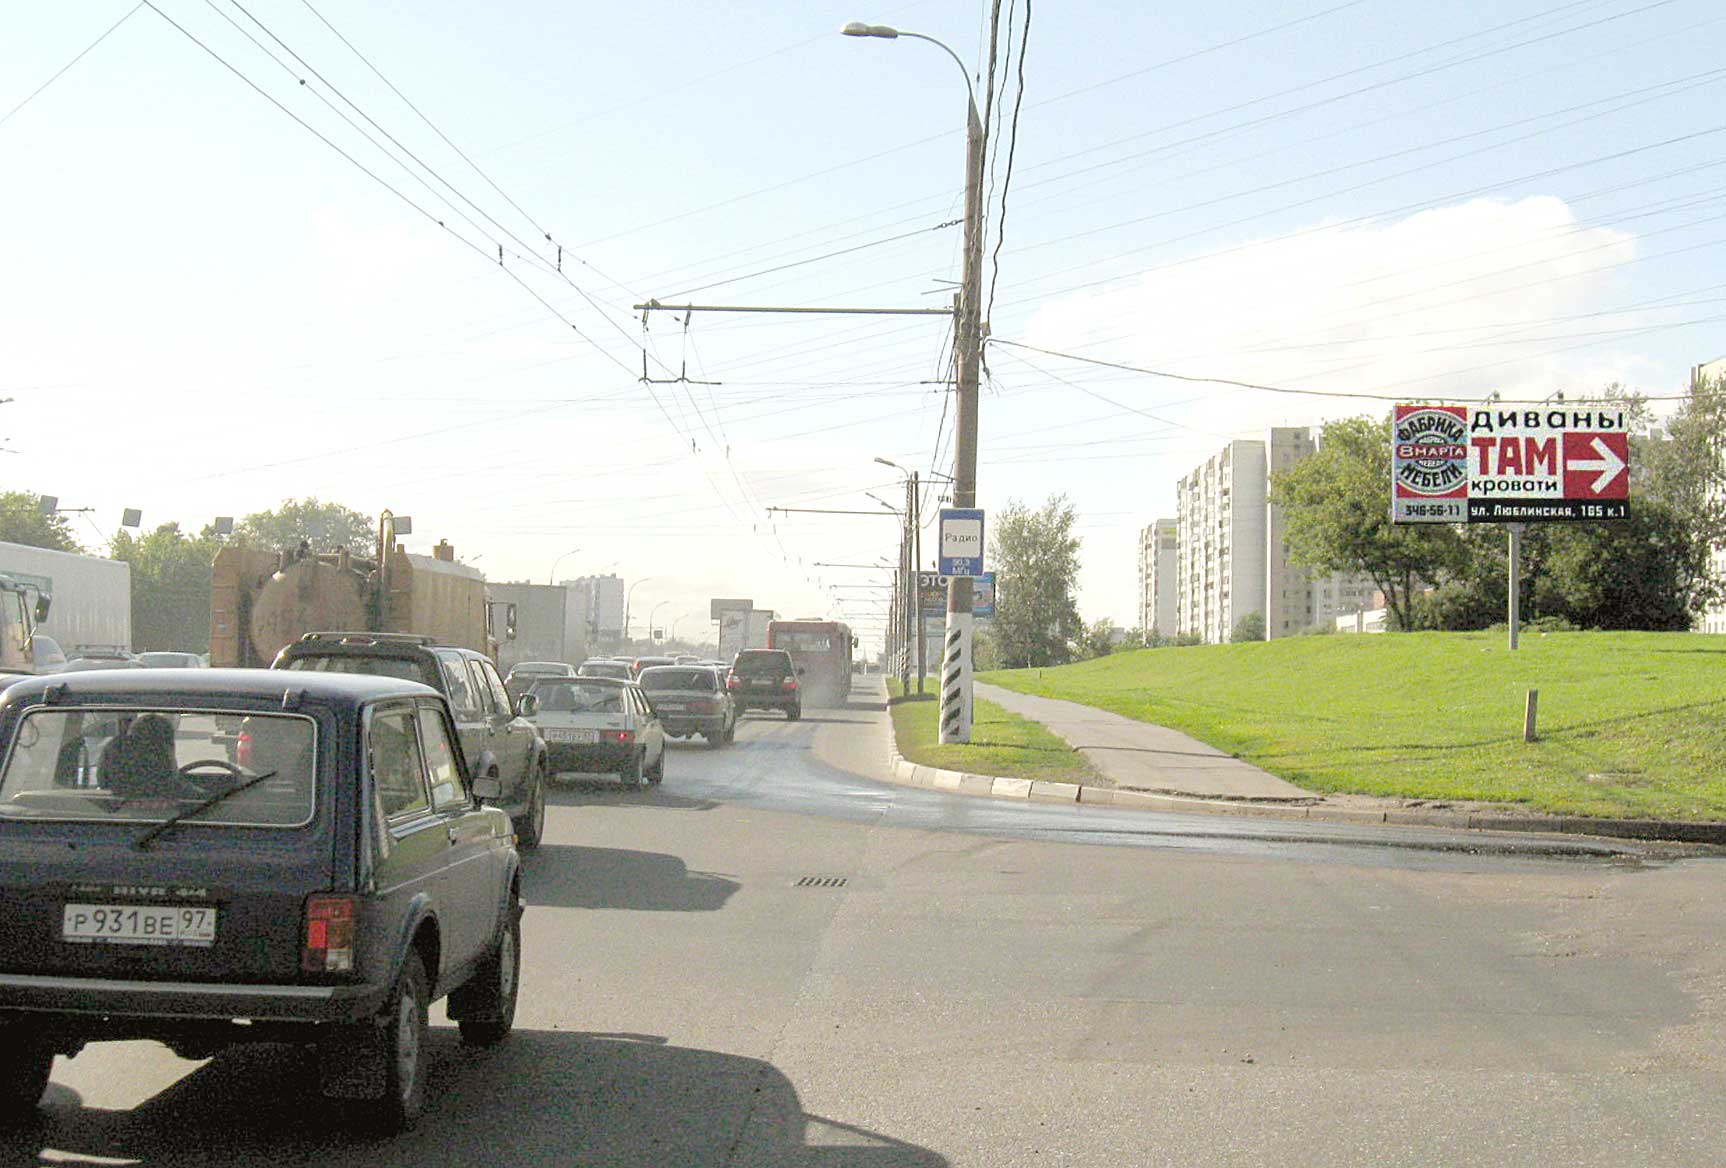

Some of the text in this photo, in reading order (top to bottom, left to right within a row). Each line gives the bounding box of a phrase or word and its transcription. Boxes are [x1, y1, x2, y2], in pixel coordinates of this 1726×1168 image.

[1398, 415, 1465, 442] ФАБРИКА
[1471, 410, 1624, 433] диваны
[1471, 436, 1558, 476] ТАМ
[1400, 463, 1464, 488] МЕБЕЛИ
[1471, 480, 1559, 495] кровати
[1405, 504, 1461, 516] 346-56-11
[1471, 506, 1490, 516] ул.
[1581, 505, 1603, 516] 165
[944, 532, 979, 543] Радио
